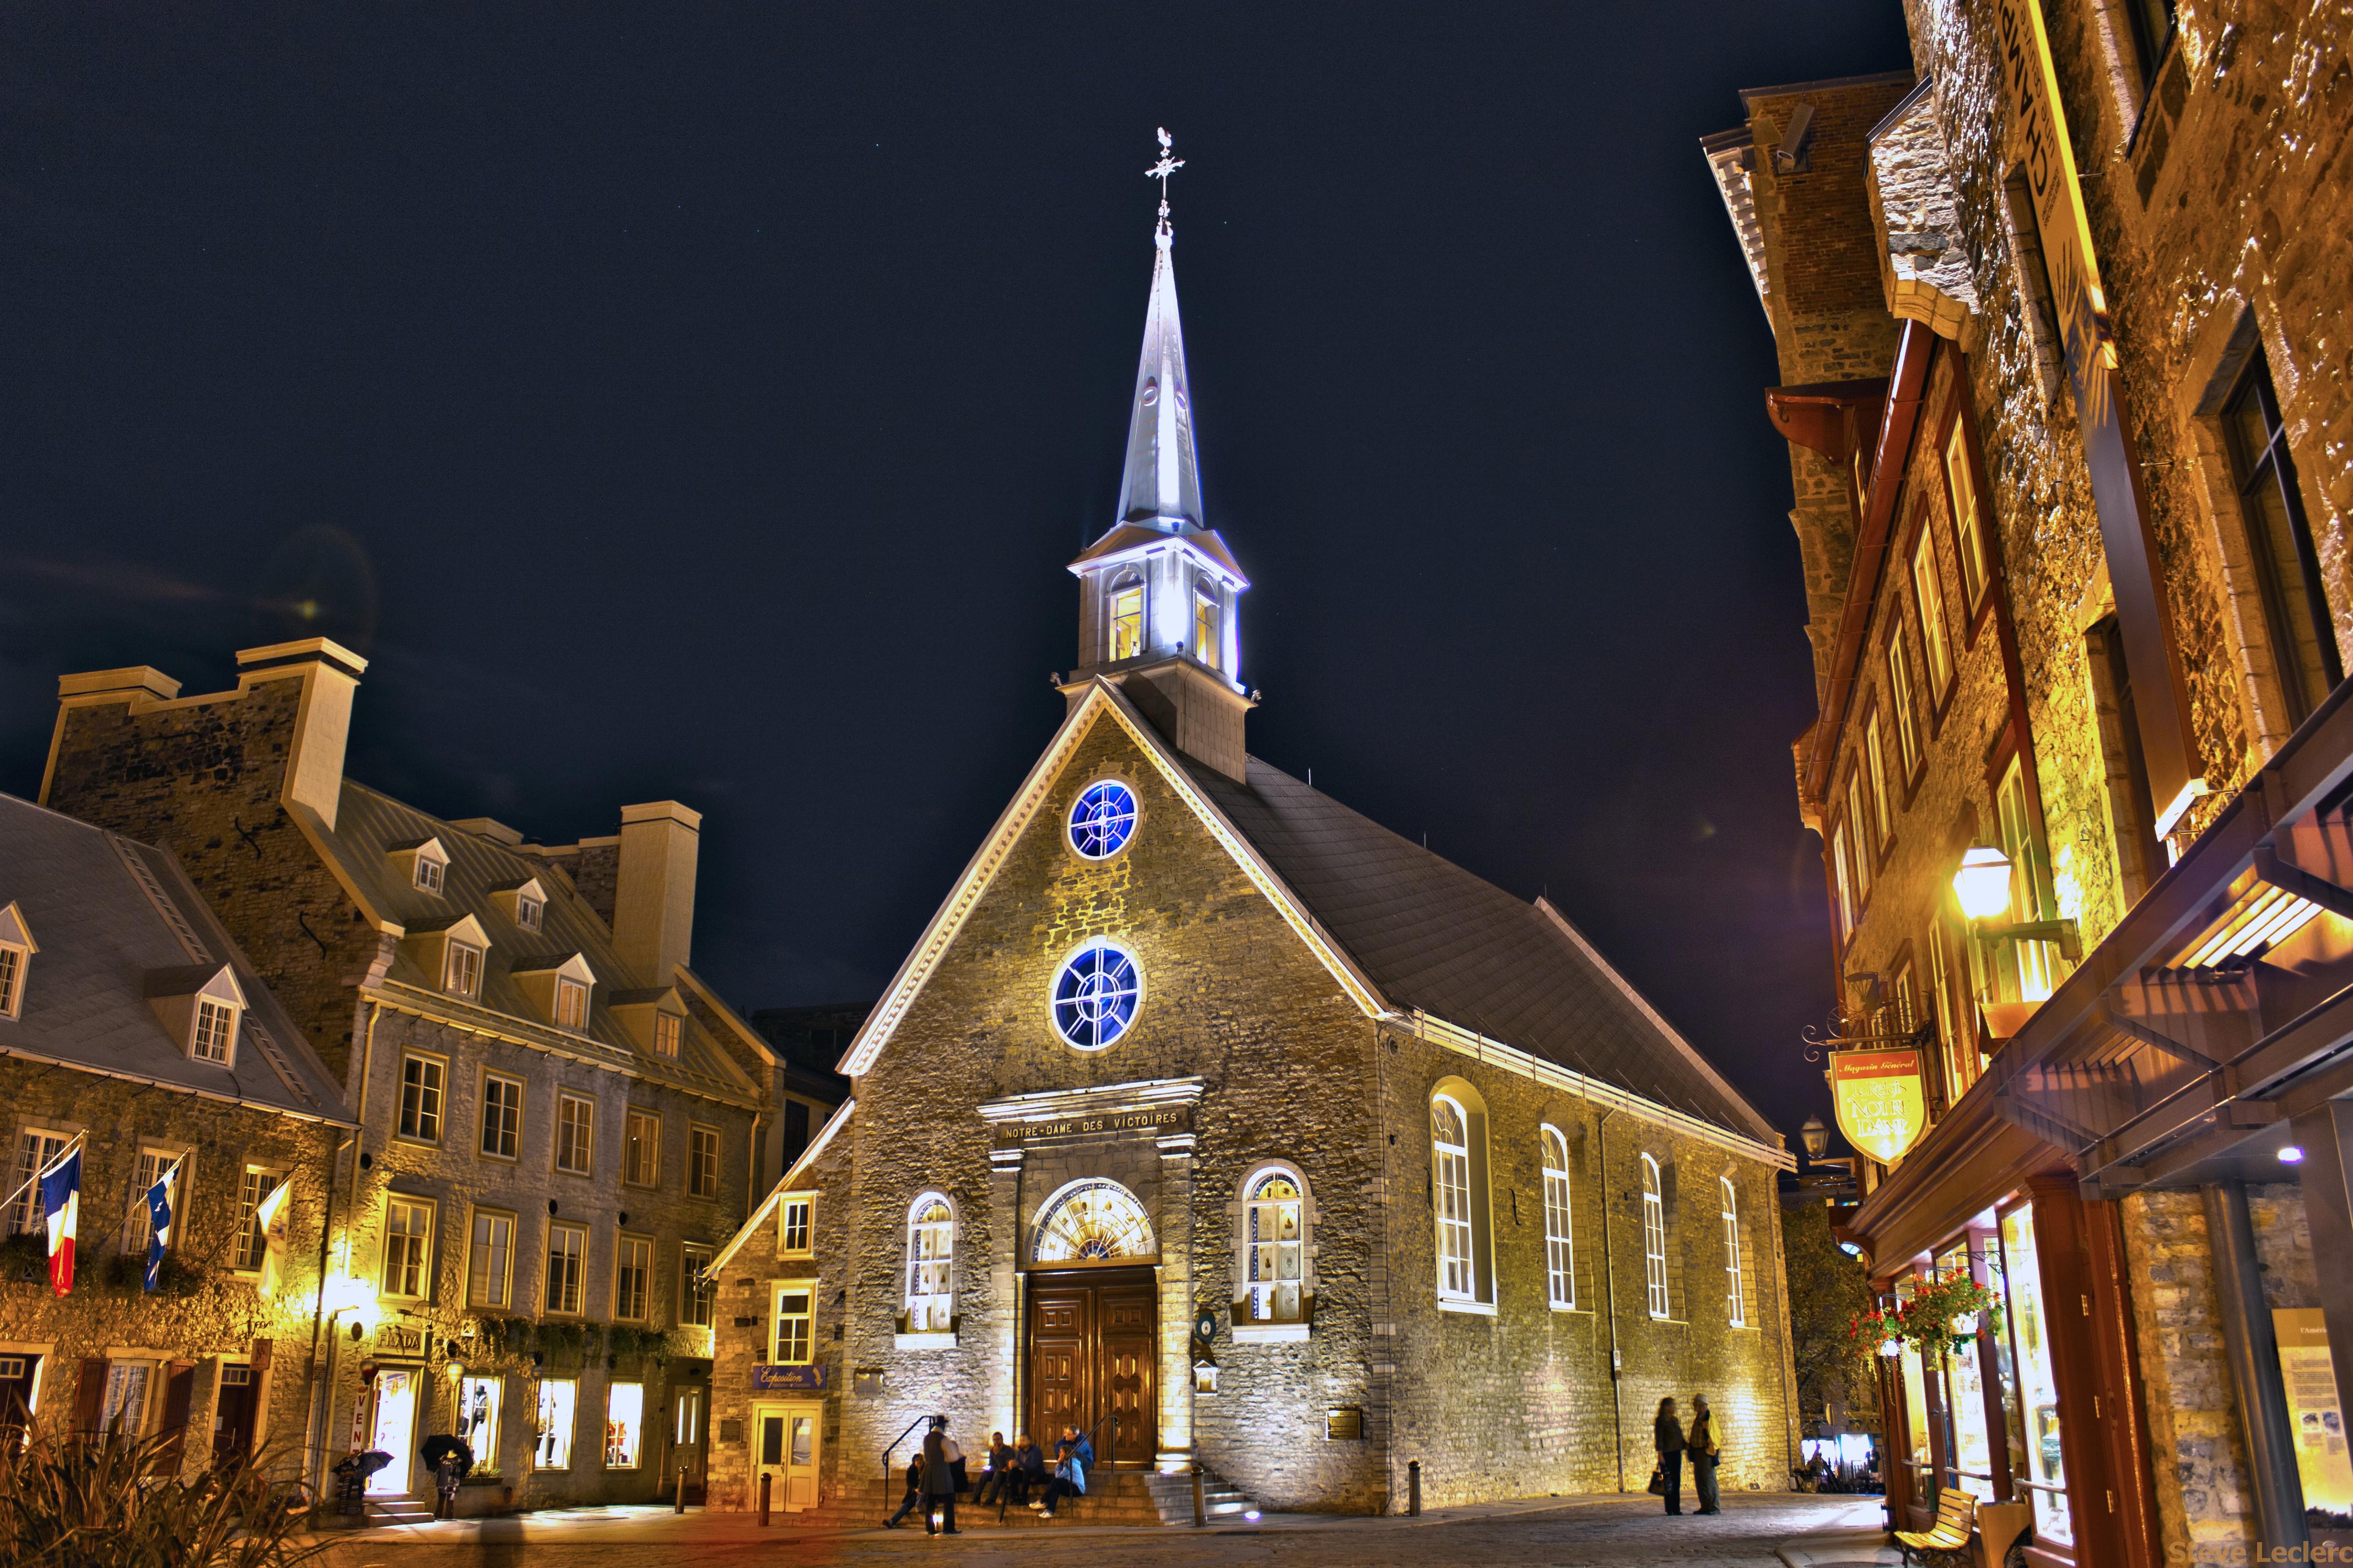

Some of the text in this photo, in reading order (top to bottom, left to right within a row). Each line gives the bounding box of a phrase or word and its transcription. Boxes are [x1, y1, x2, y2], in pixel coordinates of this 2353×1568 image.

[2041, 101, 2055, 159] une
[1839, 1059, 1914, 1074] Magasin Général
[1866, 1080, 1907, 1100] Relais
[1006, 1113, 1177, 1138] NOTRE-DAME DES VICTOIRES
[760, 1366, 803, 1388] Exposition
